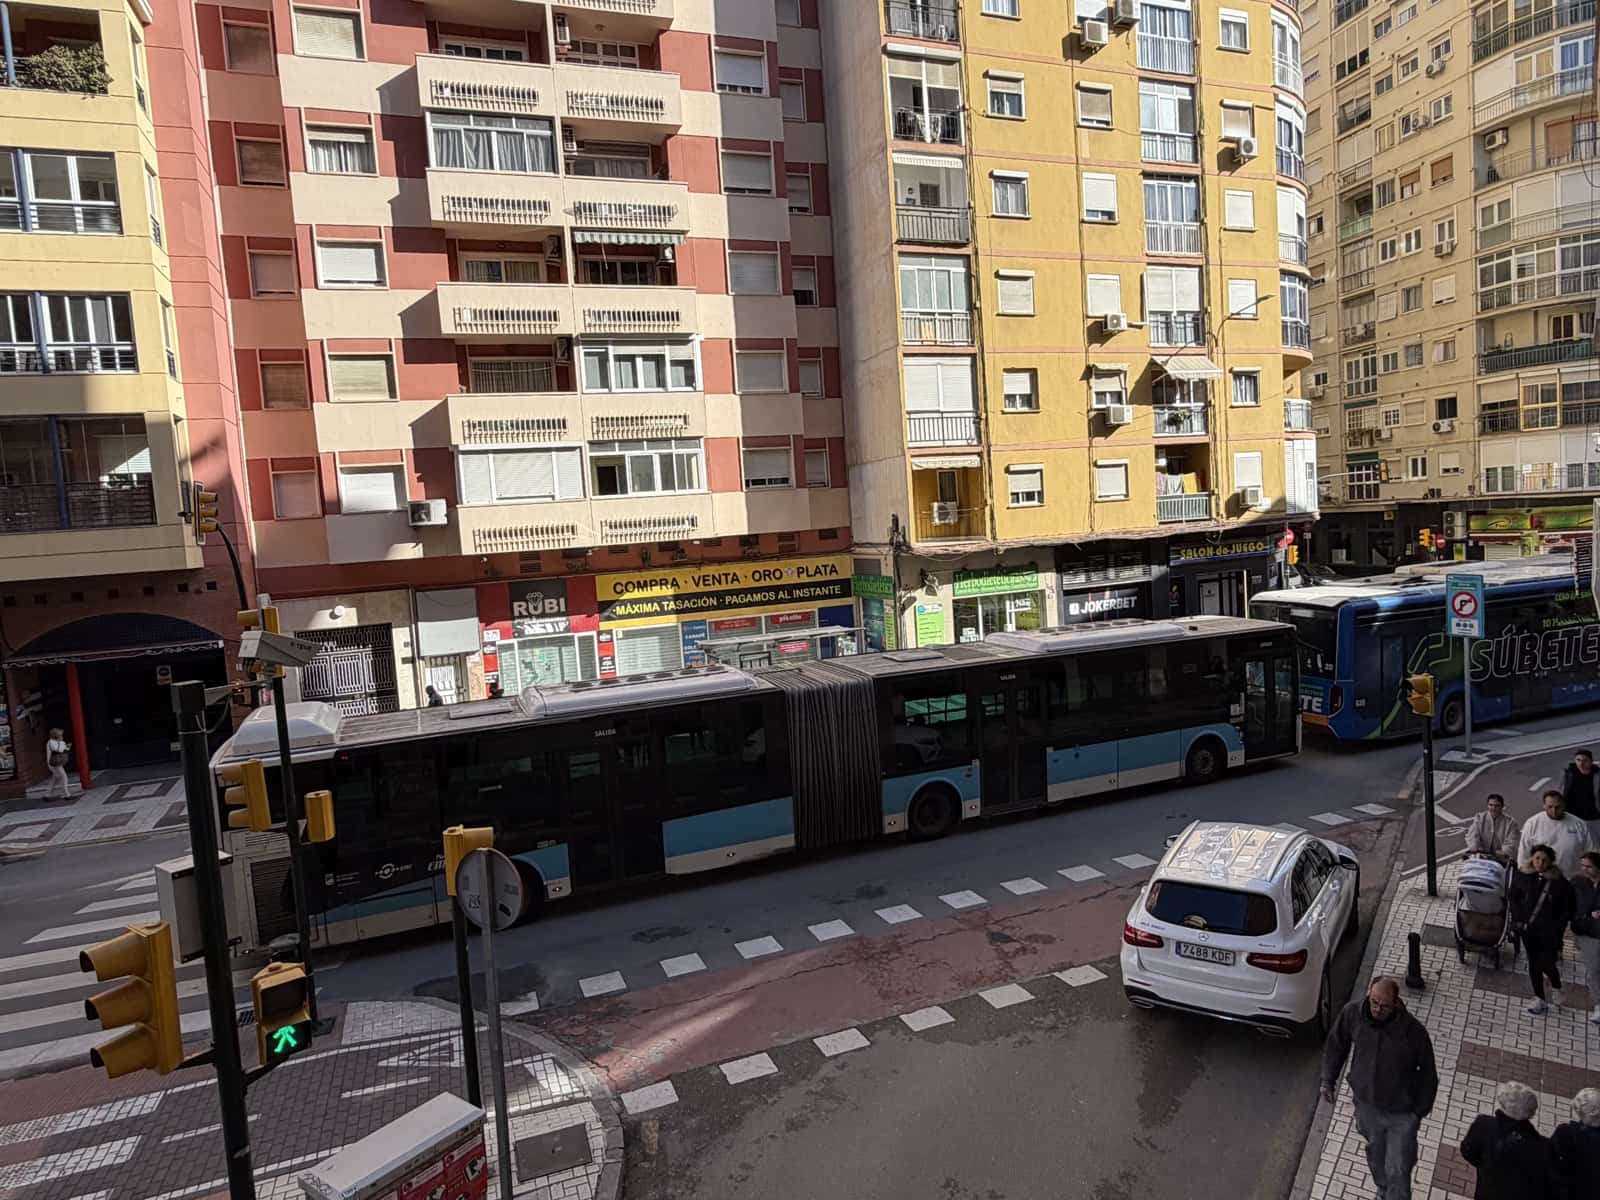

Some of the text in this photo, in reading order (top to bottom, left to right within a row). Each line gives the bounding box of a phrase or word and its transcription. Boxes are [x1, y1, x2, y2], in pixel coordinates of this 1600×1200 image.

[1230, 541, 1265, 554] JUEGO
[612, 563, 839, 596] COMPRA VENTA ORO PLATA
[615, 600, 660, 616] MÁXIMA
[662, 596, 717, 613] TASACIÓN
[725, 590, 775, 605] PAGAMOS
[776, 590, 790, 602] AL
[792, 584, 841, 600] INSTANTE
[1081, 596, 1137, 614] JOKERBET
[1183, 944, 1231, 963] 7488 KDF
